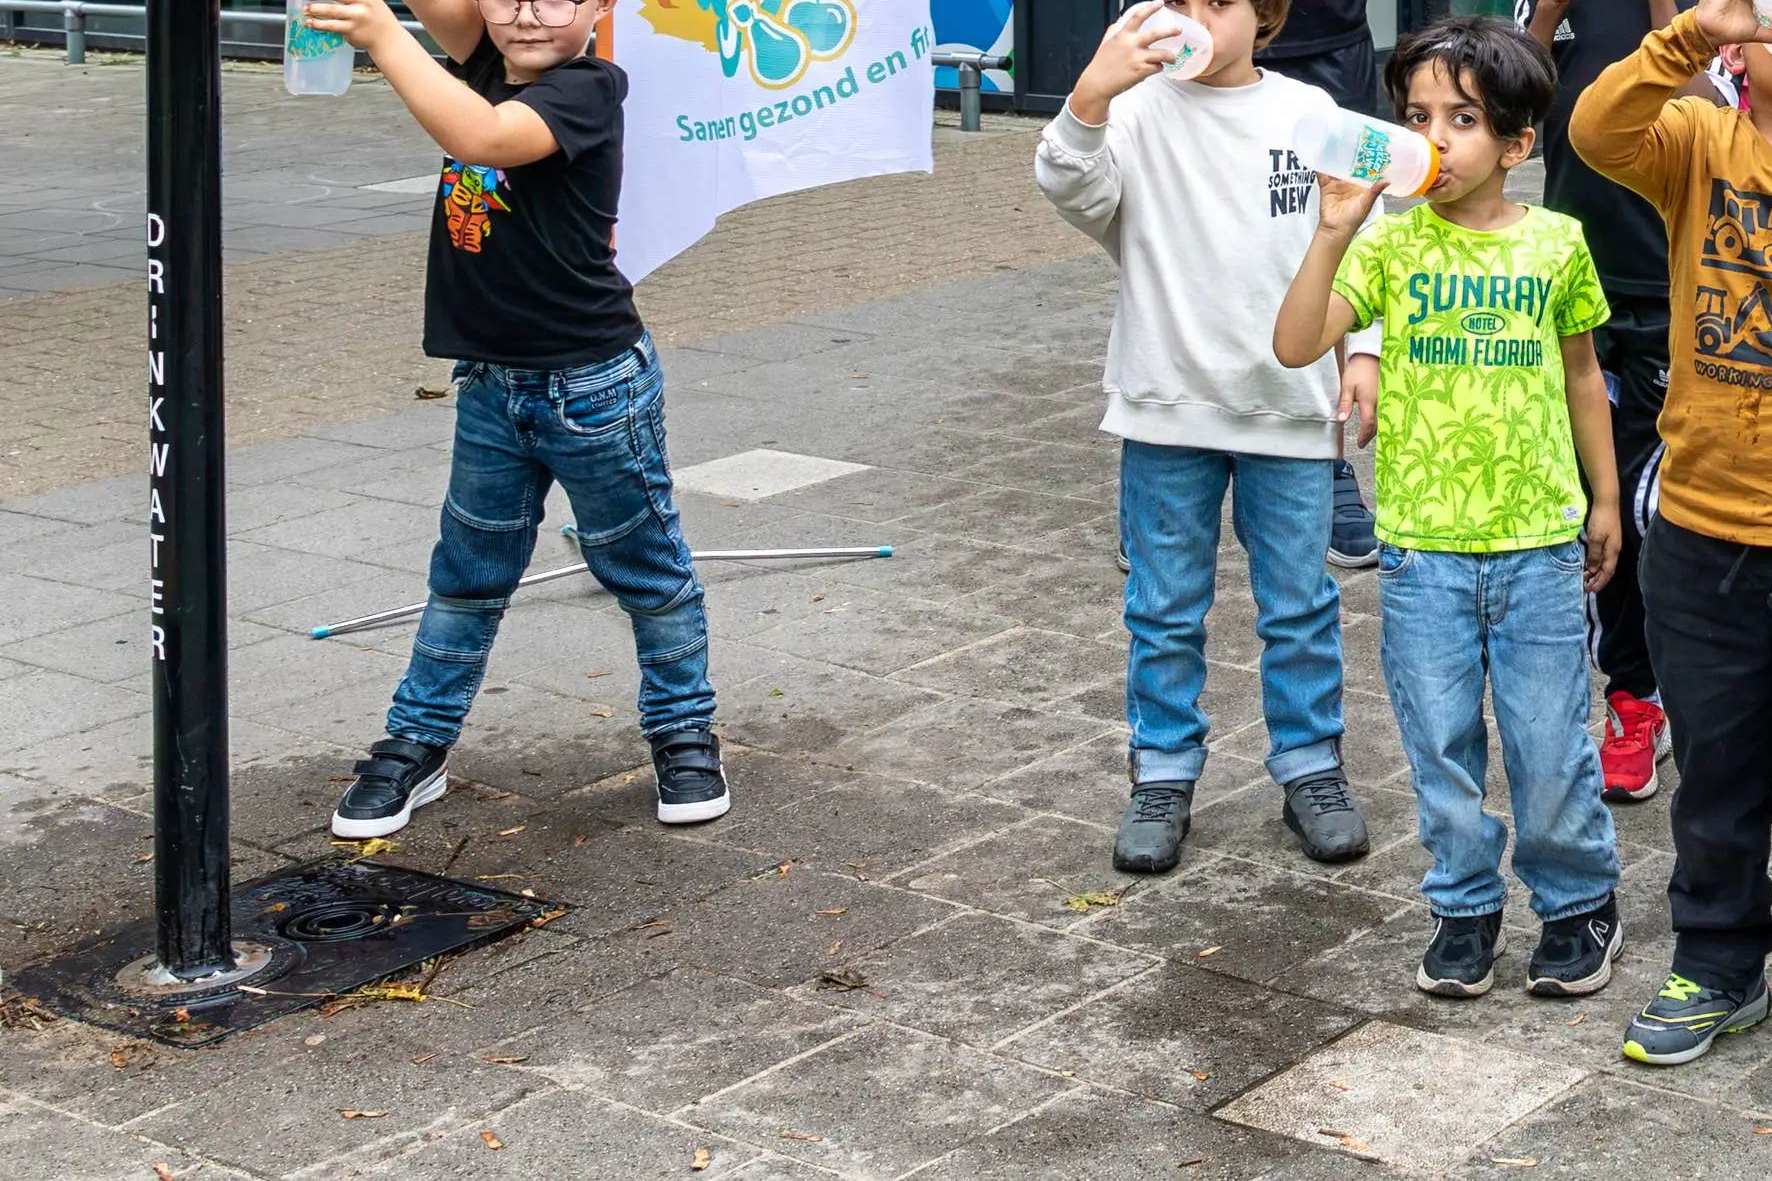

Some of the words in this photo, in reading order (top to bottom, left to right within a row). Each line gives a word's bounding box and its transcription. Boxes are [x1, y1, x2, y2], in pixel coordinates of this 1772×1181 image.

[740, 65, 860, 141] gezond
[866, 49, 908, 85] en
[1269, 149, 1308, 172] TR
[1268, 170, 1316, 188] SOMETHING
[1270, 185, 1312, 217] NEW
[1408, 273, 1553, 329] SUNRAY
[1468, 317, 1497, 331] HOTEL
[1409, 335, 1466, 365] MIAMI
[1474, 337, 1543, 366] FLORIDA
[147, 213, 169, 661] DRINKWATER
